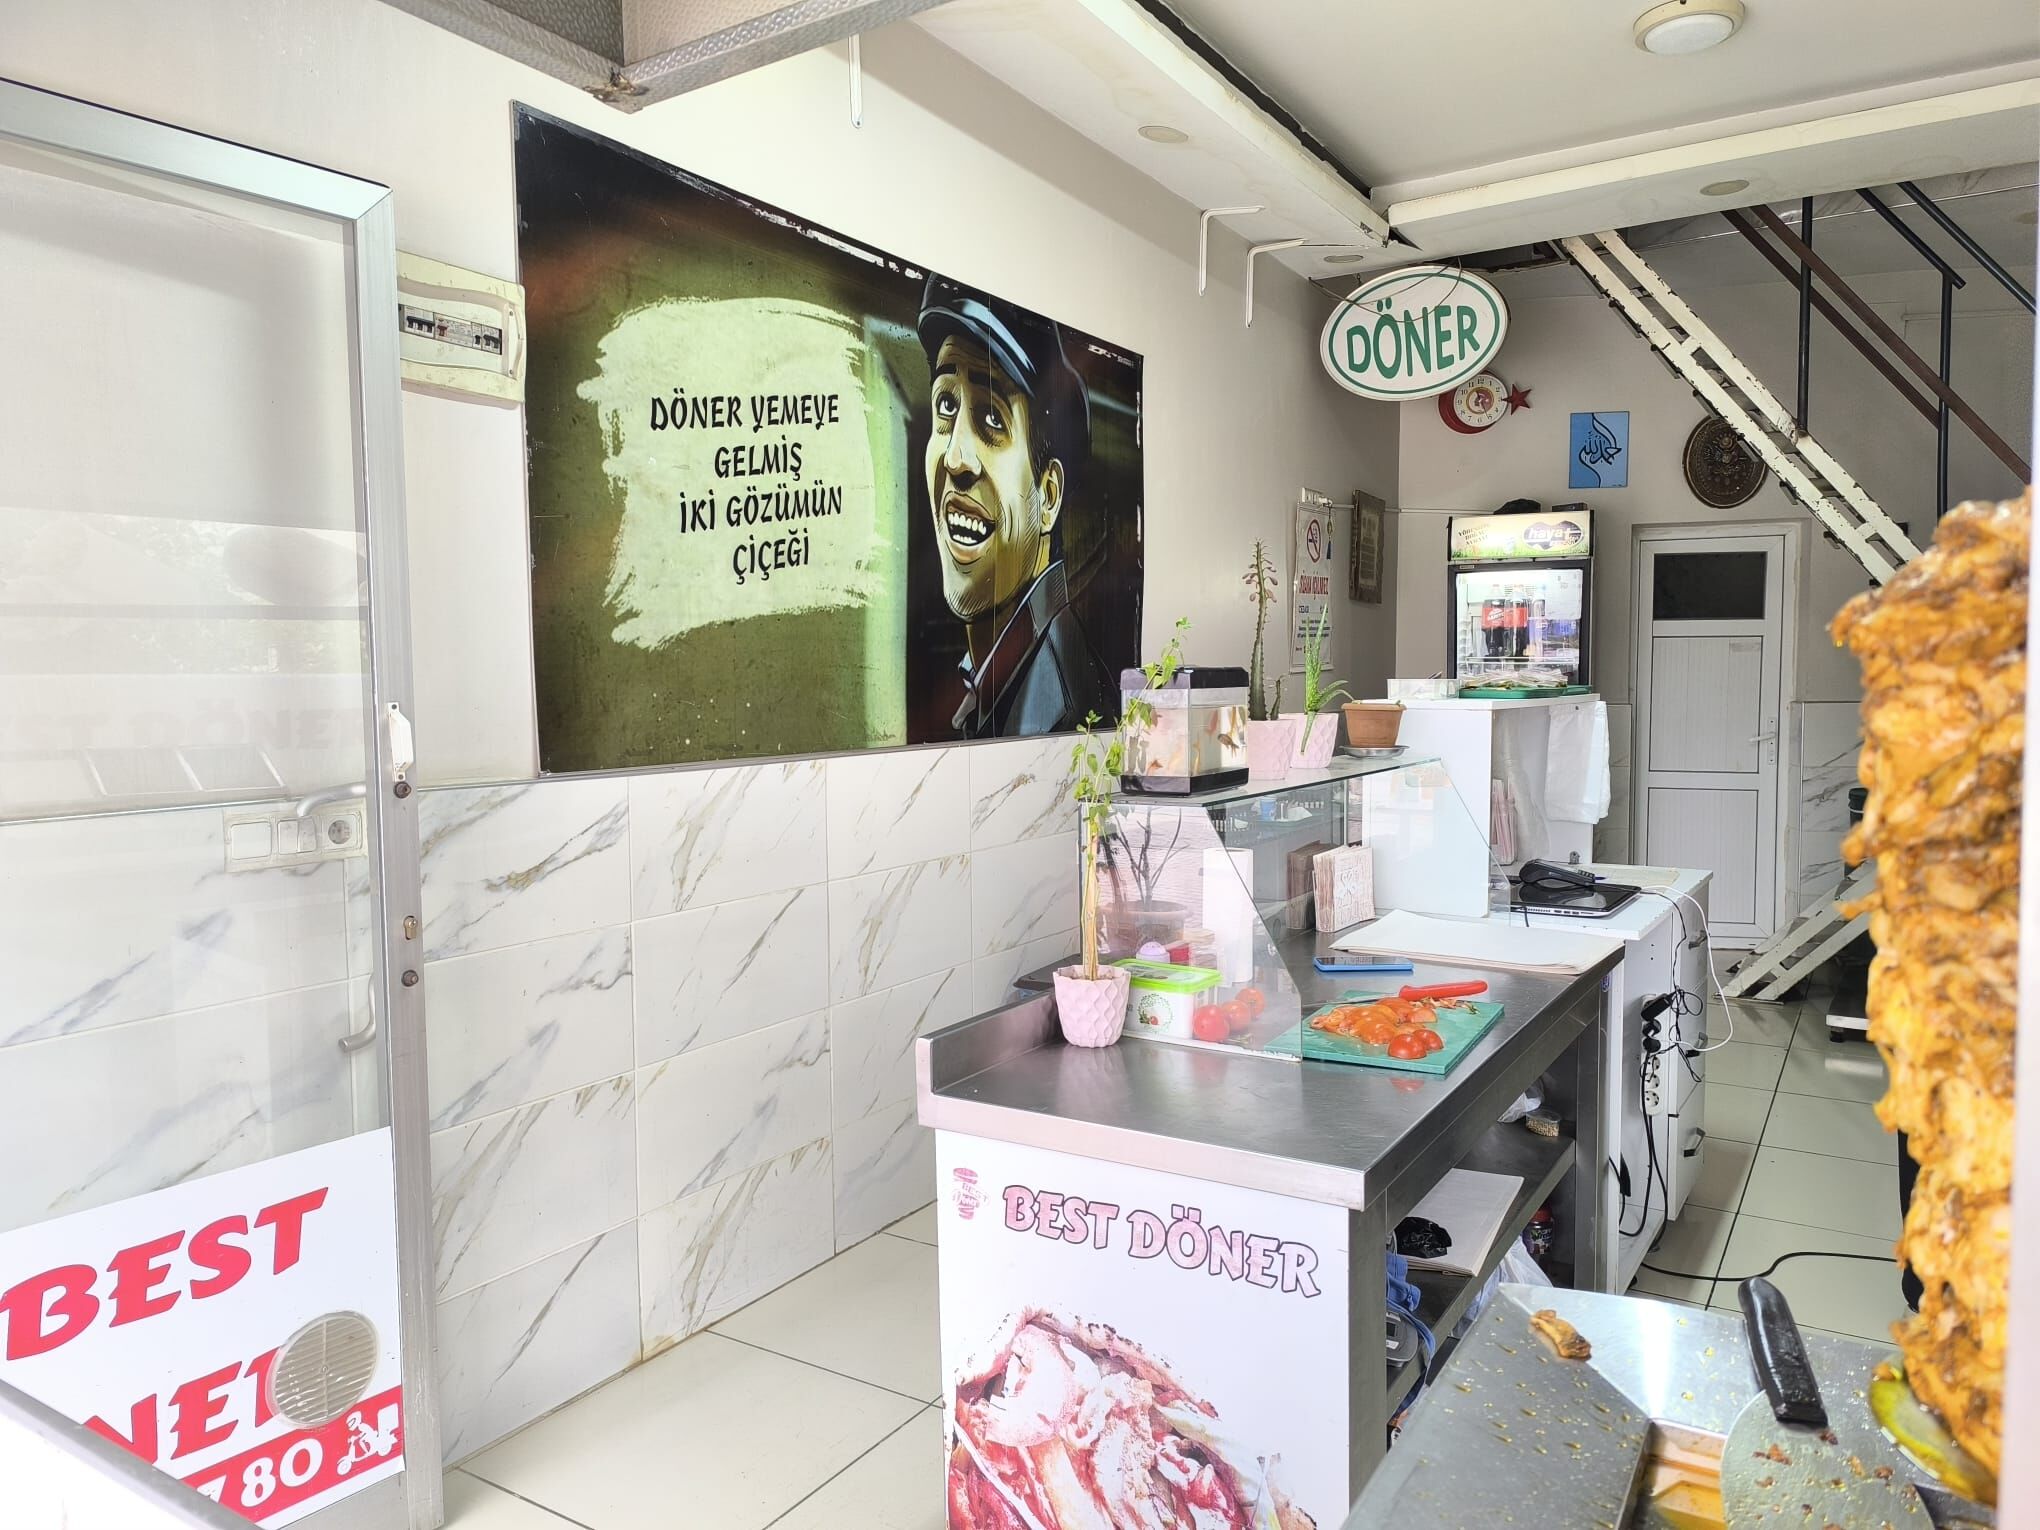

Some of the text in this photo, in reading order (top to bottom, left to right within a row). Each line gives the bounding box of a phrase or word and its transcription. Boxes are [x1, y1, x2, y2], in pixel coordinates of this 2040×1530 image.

[1346, 297, 1480, 379] DÖNER
[650, 388, 840, 433] DÖNER YEMEYE
[714, 434, 803, 481] GELMİŞ
[679, 479, 843, 534] İKİ GÖZÜMÜN
[732, 527, 810, 585] ÇİÇEĞİ
[1003, 1185, 1322, 1298] BEST DÖNER
[0, 1187, 330, 1361] BEST
